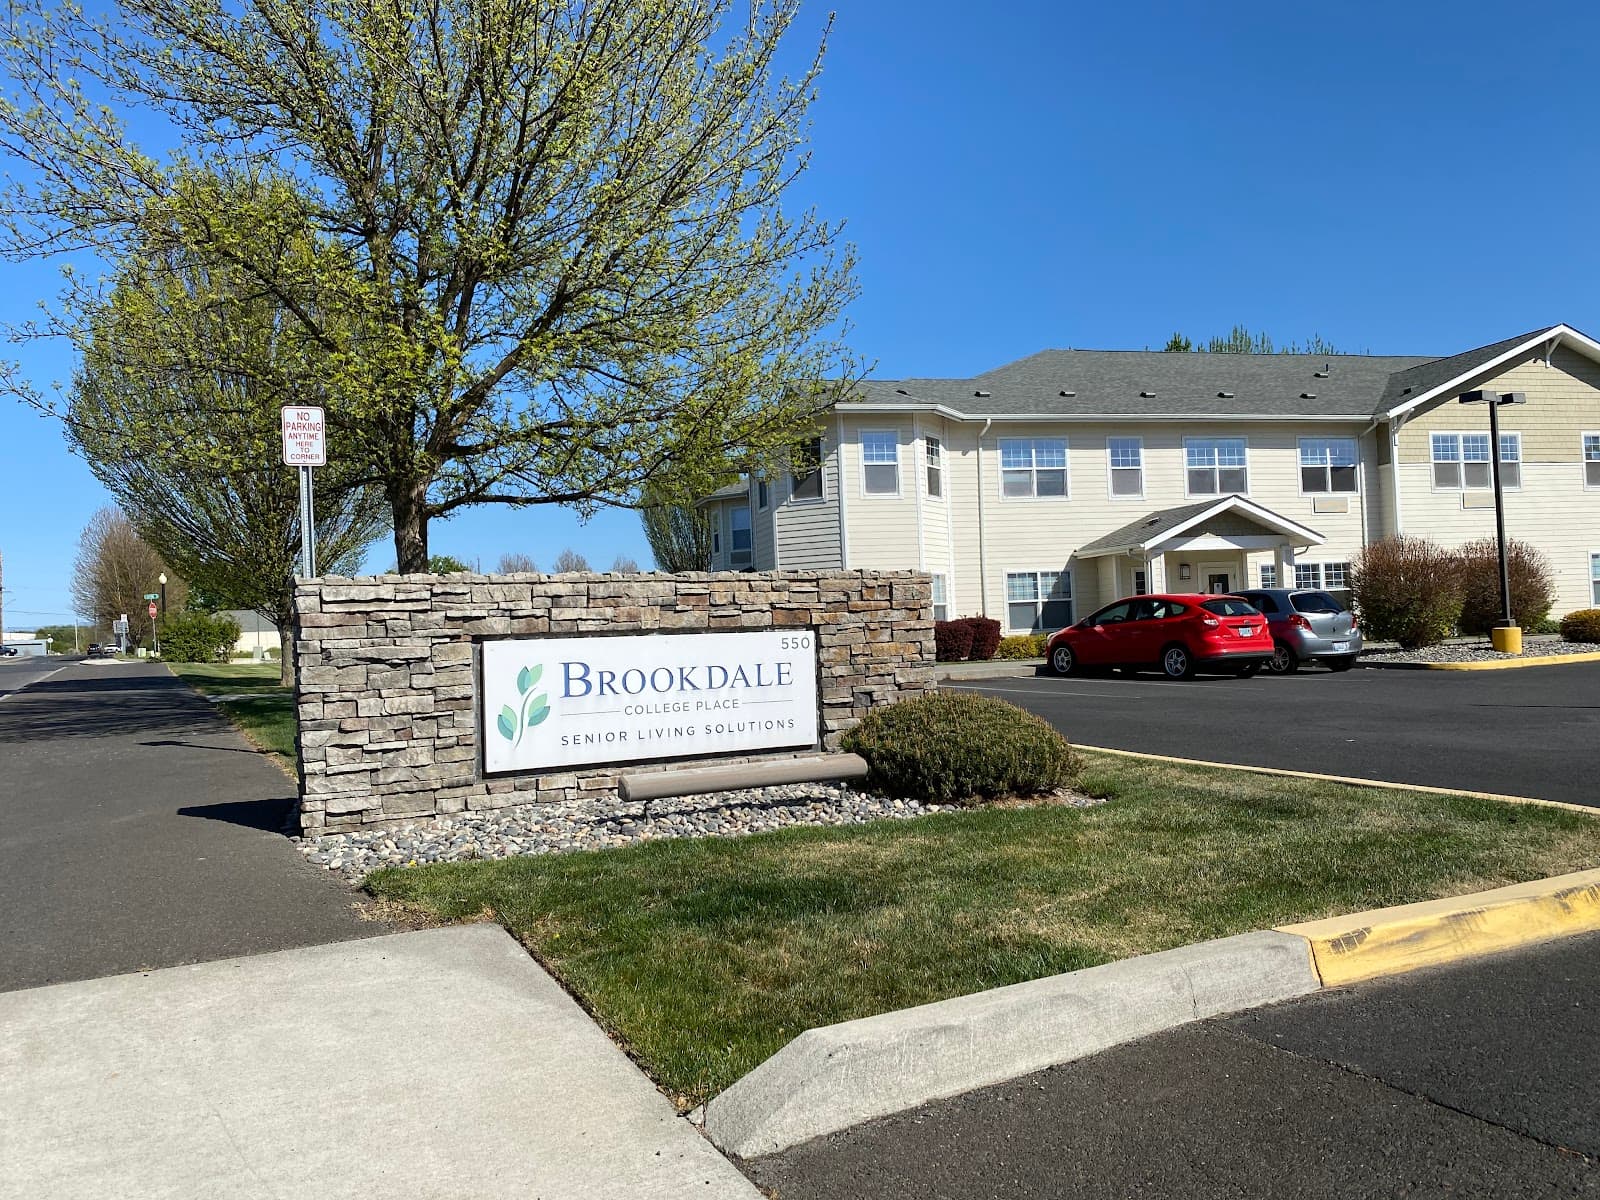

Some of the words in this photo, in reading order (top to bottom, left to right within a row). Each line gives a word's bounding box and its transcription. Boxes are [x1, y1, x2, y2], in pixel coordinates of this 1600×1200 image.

[296, 411, 310, 421] NO
[285, 422, 321, 432] PARKING
[288, 432, 319, 440] ANYTIME
[781, 637, 810, 650] 550
[559, 661, 794, 698] BROOKDALE
[624, 702, 690, 716] COLLEGE
[696, 699, 740, 711] PLACE
[561, 731, 628, 746] SENIOR
[638, 726, 696, 740] LIVING
[705, 719, 795, 735] SOLUTIONS
